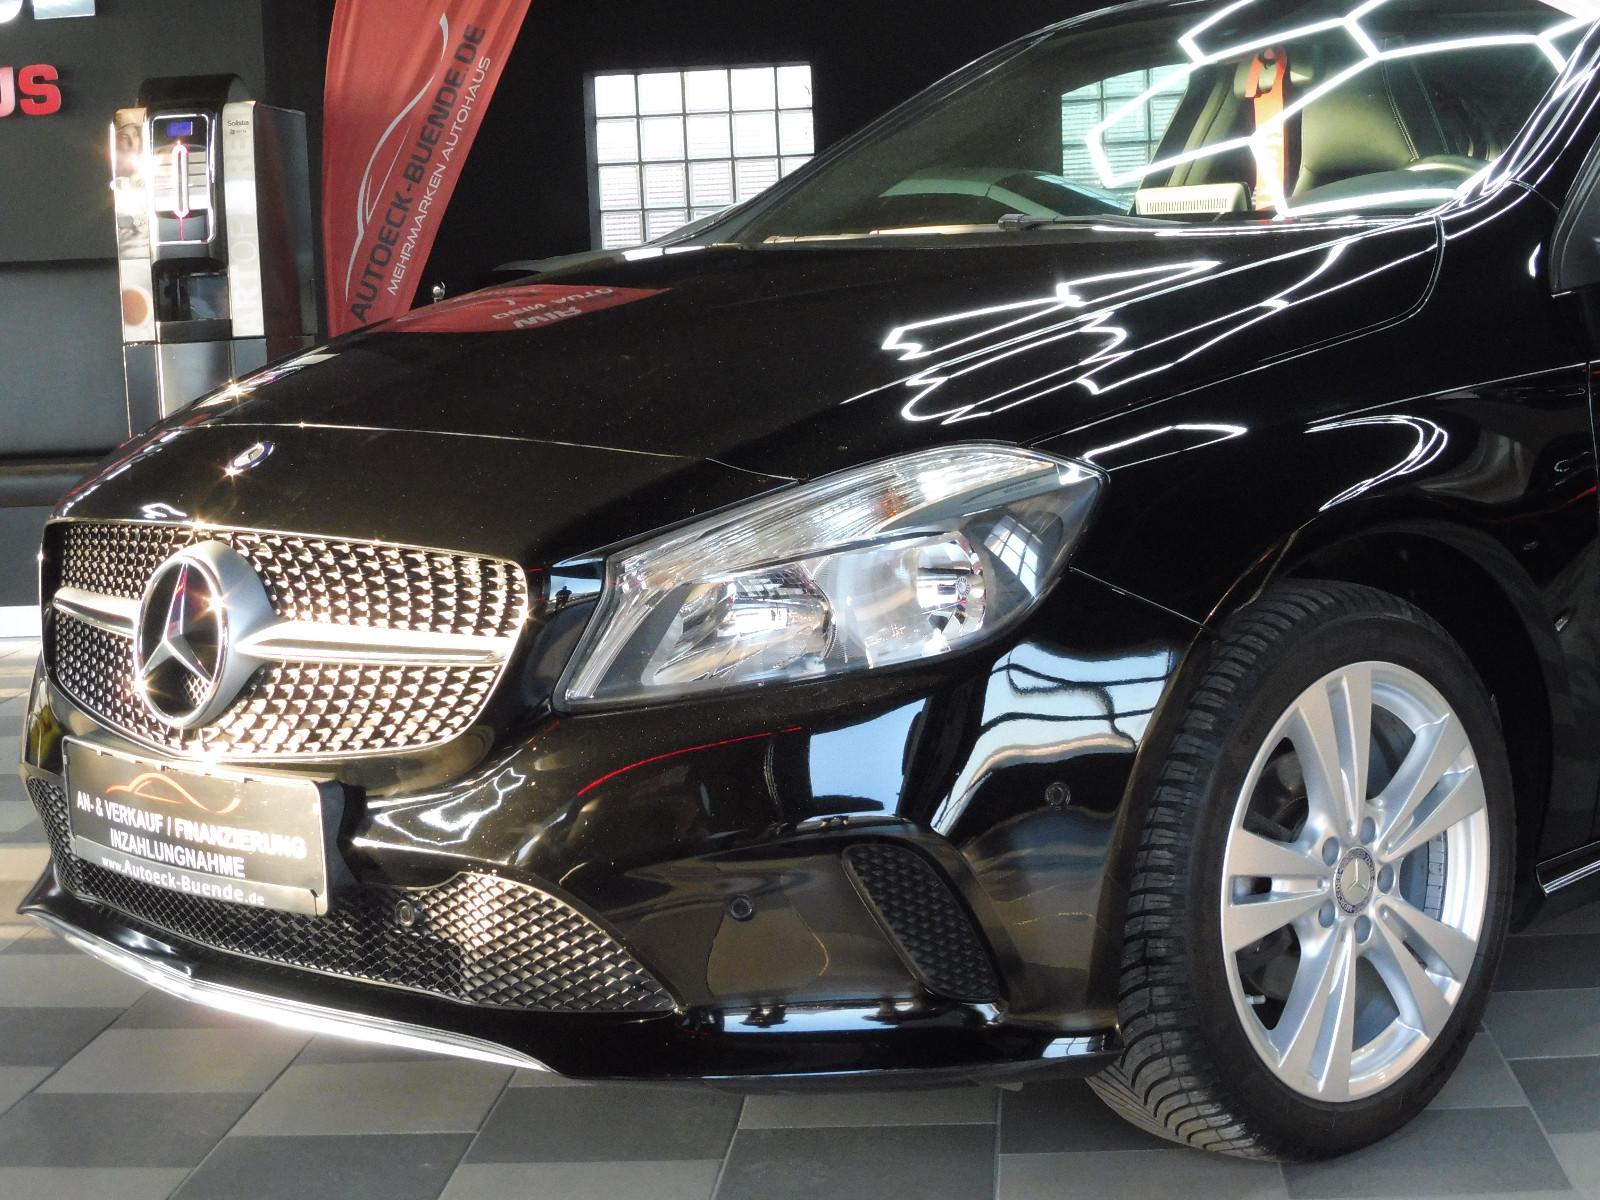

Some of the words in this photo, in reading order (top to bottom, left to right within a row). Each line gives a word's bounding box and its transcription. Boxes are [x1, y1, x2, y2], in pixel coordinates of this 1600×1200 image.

[351, 23, 486, 324] AUTOECK-BUENDE.DE
[387, 163, 447, 296] MEHRMARKEN
[441, 56, 491, 162] AUTOHAUS
[95, 796, 104, 817] &
[104, 800, 164, 834] VERKAUF
[174, 817, 308, 860] FINANZIERUNG
[110, 827, 246, 879] INZAHLUNGNAHME
